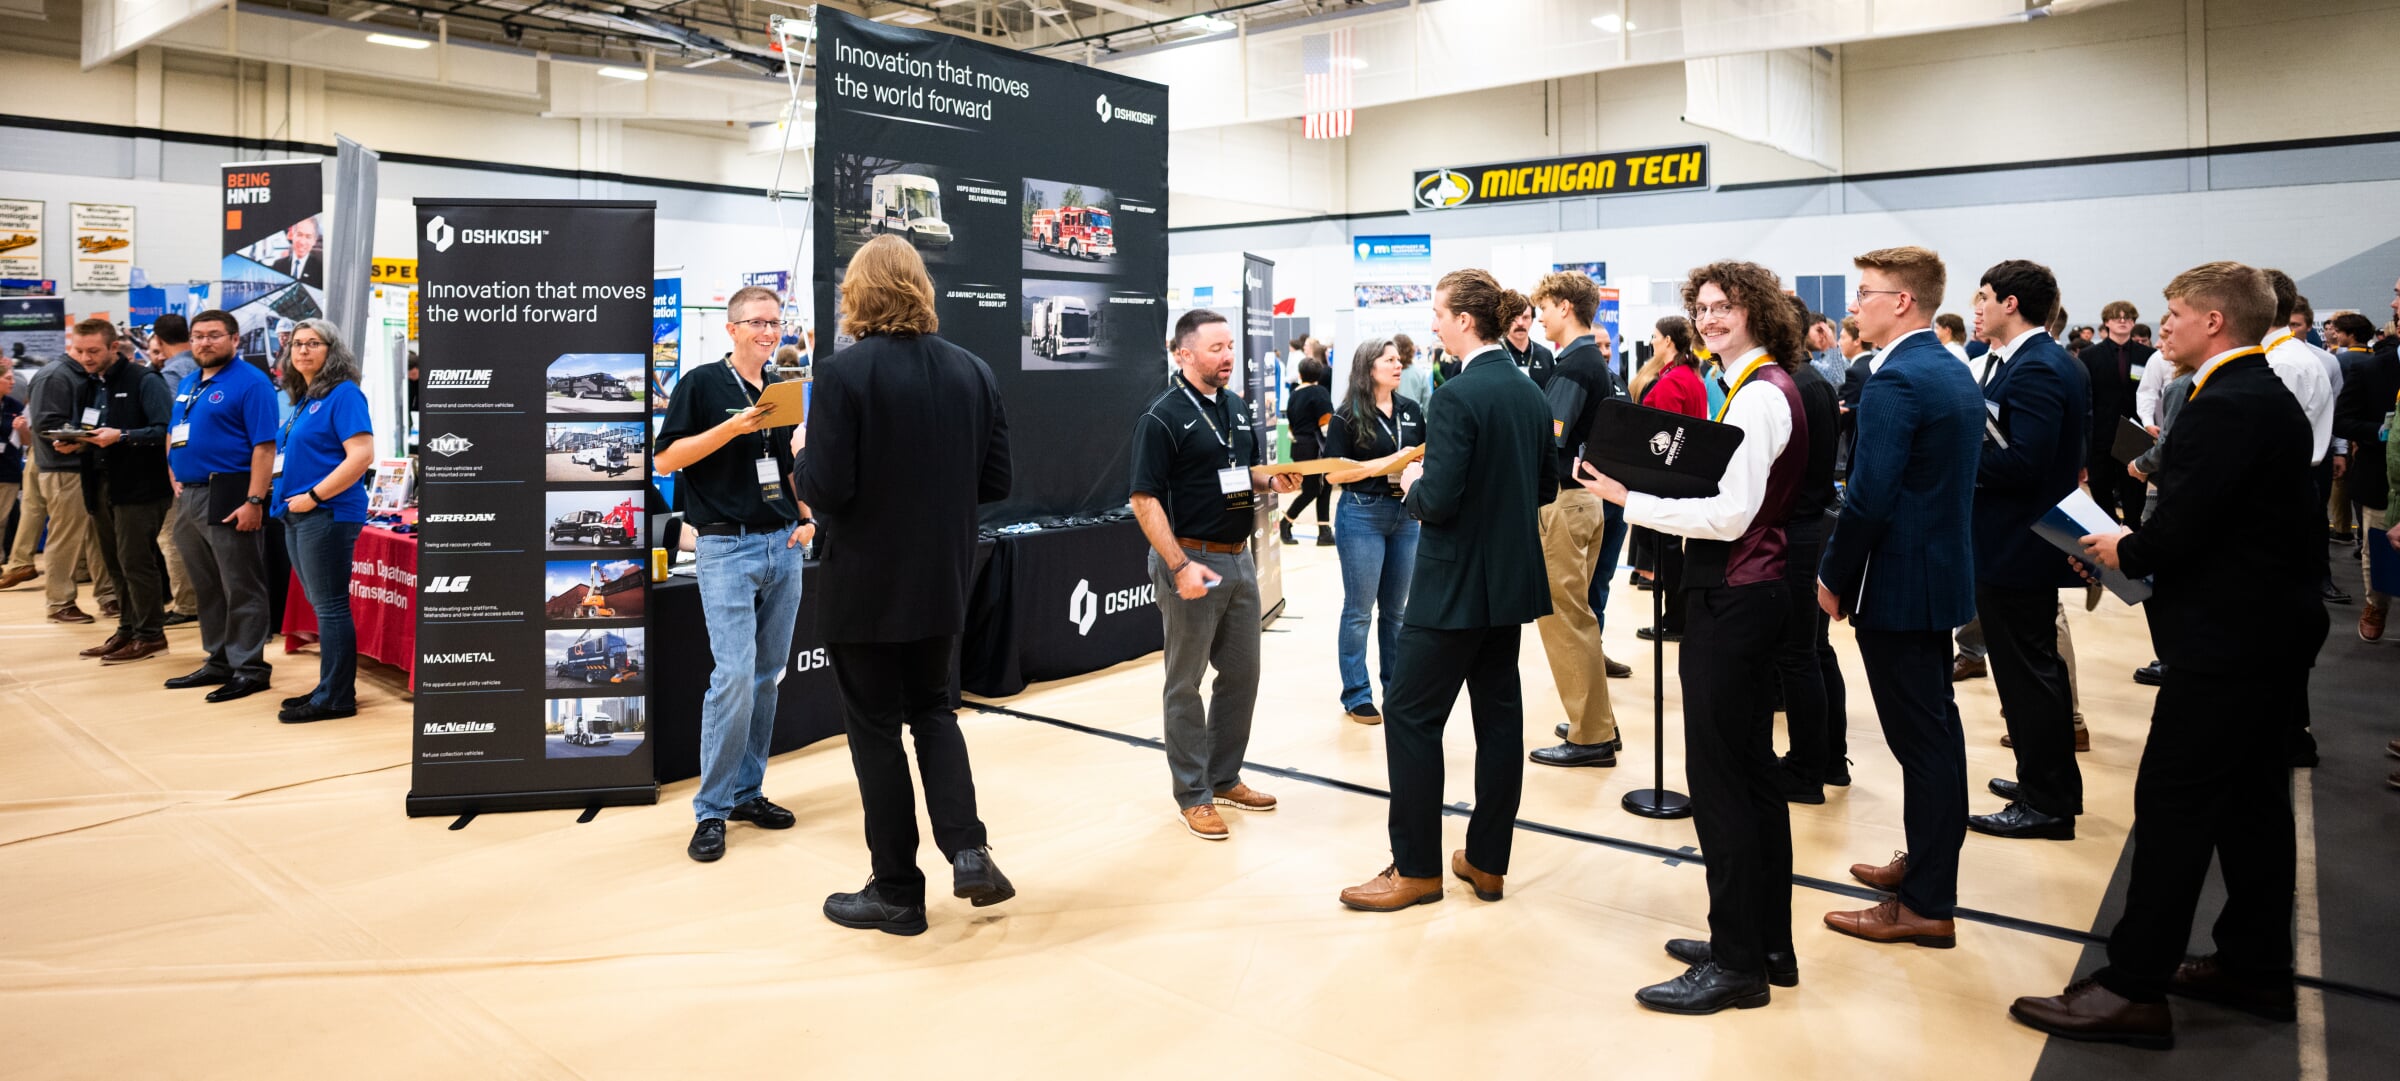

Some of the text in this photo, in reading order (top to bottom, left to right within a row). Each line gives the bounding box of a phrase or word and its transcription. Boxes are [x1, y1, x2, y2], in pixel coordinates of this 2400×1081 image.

[834, 38, 1030, 99] Innovation that moves
[834, 75, 992, 121] the world forward
[227, 171, 271, 188] BEING
[1479, 151, 1702, 199] MICHIGAN TECH
[226, 187, 271, 205] HNTB
[427, 280, 647, 300] Innovation that moves
[667, 293, 677, 306] of
[427, 304, 598, 323] the world forward
[428, 369, 494, 381] FRONTLINE
[1673, 426, 1685, 441] TECH
[431, 438, 469, 452] IMT
[424, 575, 472, 593] JLG
[423, 652, 496, 664] MAXIMETAL
[797, 647, 831, 673] OS
[431, 681, 457, 689] apparatus
[423, 721, 497, 735] McNeilus
